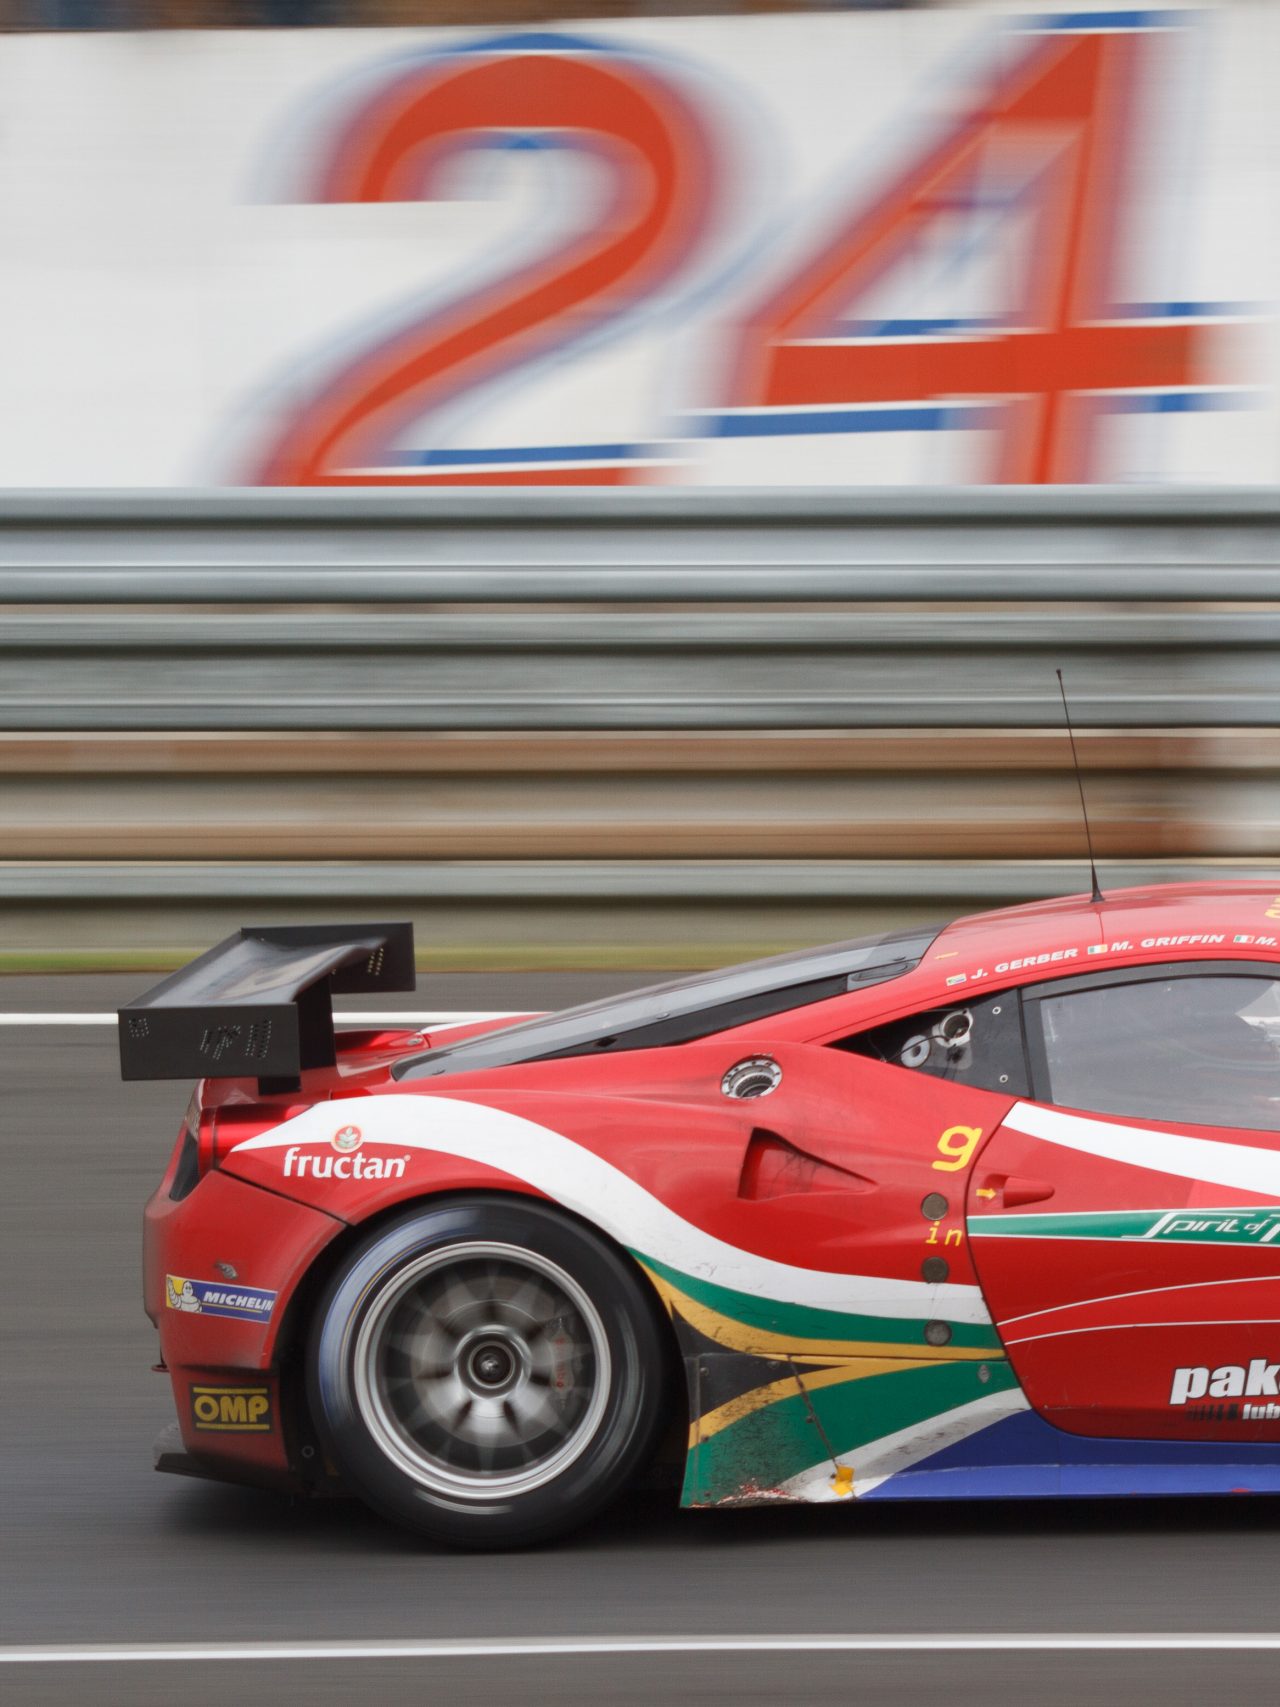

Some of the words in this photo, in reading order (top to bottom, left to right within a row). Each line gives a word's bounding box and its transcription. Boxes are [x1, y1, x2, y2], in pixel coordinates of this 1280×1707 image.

[245, 10, 1270, 487] 24
[970, 968, 988, 979] J.
[995, 948, 1078, 973] GERBER
[1111, 941, 1133, 952] M.
[1140, 934, 1225, 948] GRIFFIN
[1254, 936, 1278, 946] M.
[283, 1146, 407, 1180] fructan
[931, 1125, 983, 1172] g
[925, 1221, 962, 1246] in
[1121, 1212, 1255, 1239] Spirit
[1244, 1219, 1270, 1235] of
[203, 1291, 274, 1311] MICHELIN
[194, 1395, 269, 1422] OMP
